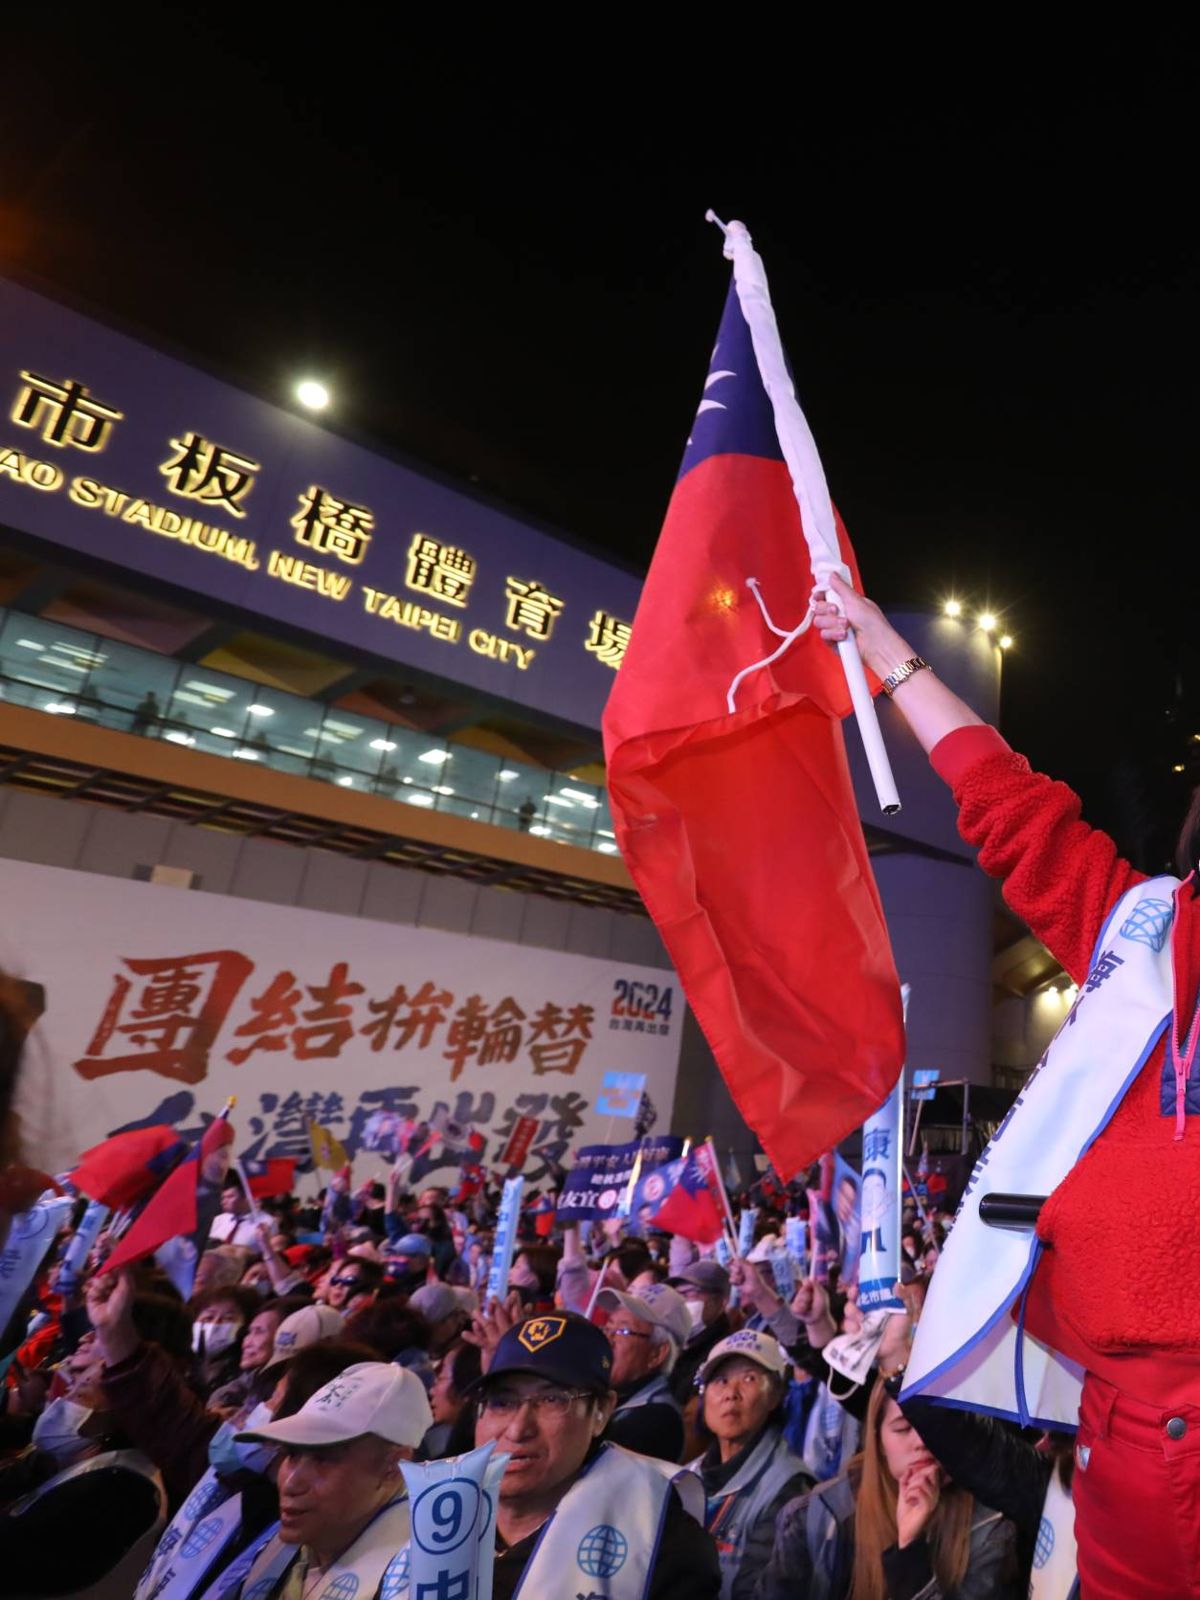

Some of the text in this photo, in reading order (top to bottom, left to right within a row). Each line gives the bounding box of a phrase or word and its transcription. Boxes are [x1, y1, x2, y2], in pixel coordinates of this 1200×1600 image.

[10, 370, 633, 671] 市板橋體育場
[267, 550, 352, 601] NEW
[362, 585, 460, 644] TAIPEI
[469, 628, 536, 670] CITY
[612, 979, 672, 1021] 2024
